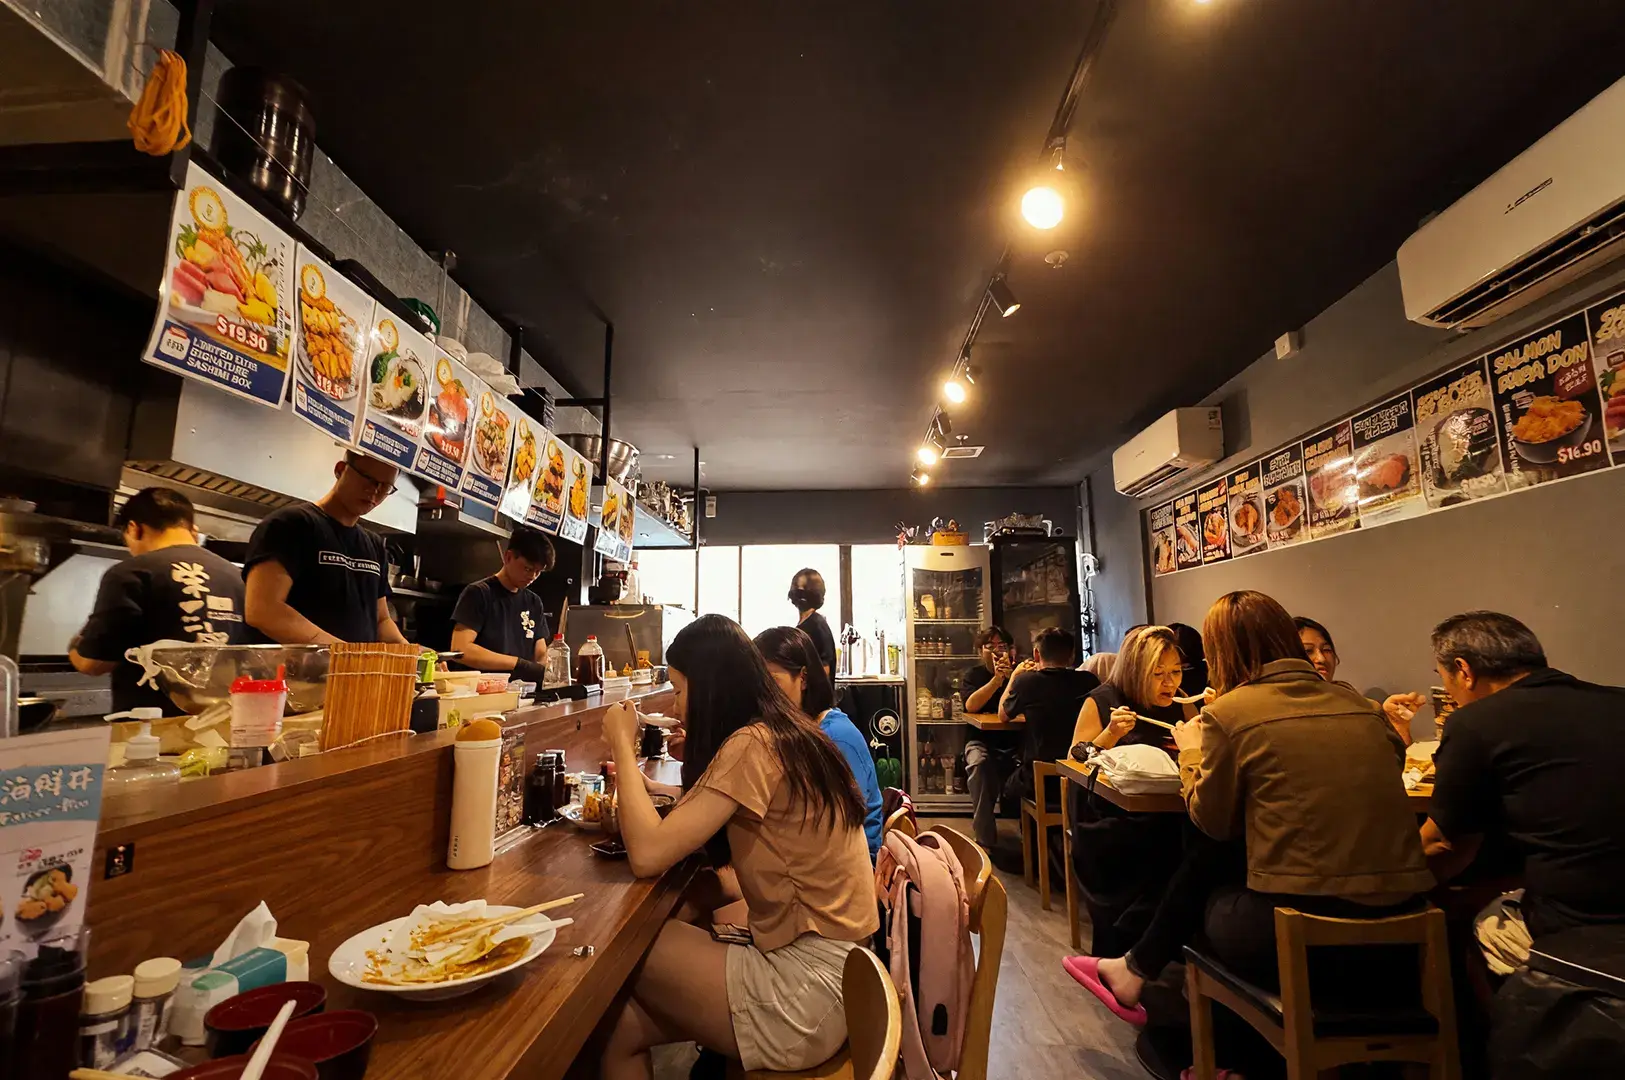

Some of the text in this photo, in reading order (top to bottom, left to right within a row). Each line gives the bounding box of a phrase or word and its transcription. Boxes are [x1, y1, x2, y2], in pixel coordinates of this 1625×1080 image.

[193, 337, 234, 361] LIMITED
[216, 313, 268, 353] $19.90
[190, 347, 250, 378] SIGNATURE
[1494, 330, 1561, 375] SALMON
[1546, 341, 1588, 374] DON
[187, 356, 253, 390] SASHIMI BOX
[1557, 439, 1602, 465] $16.90
